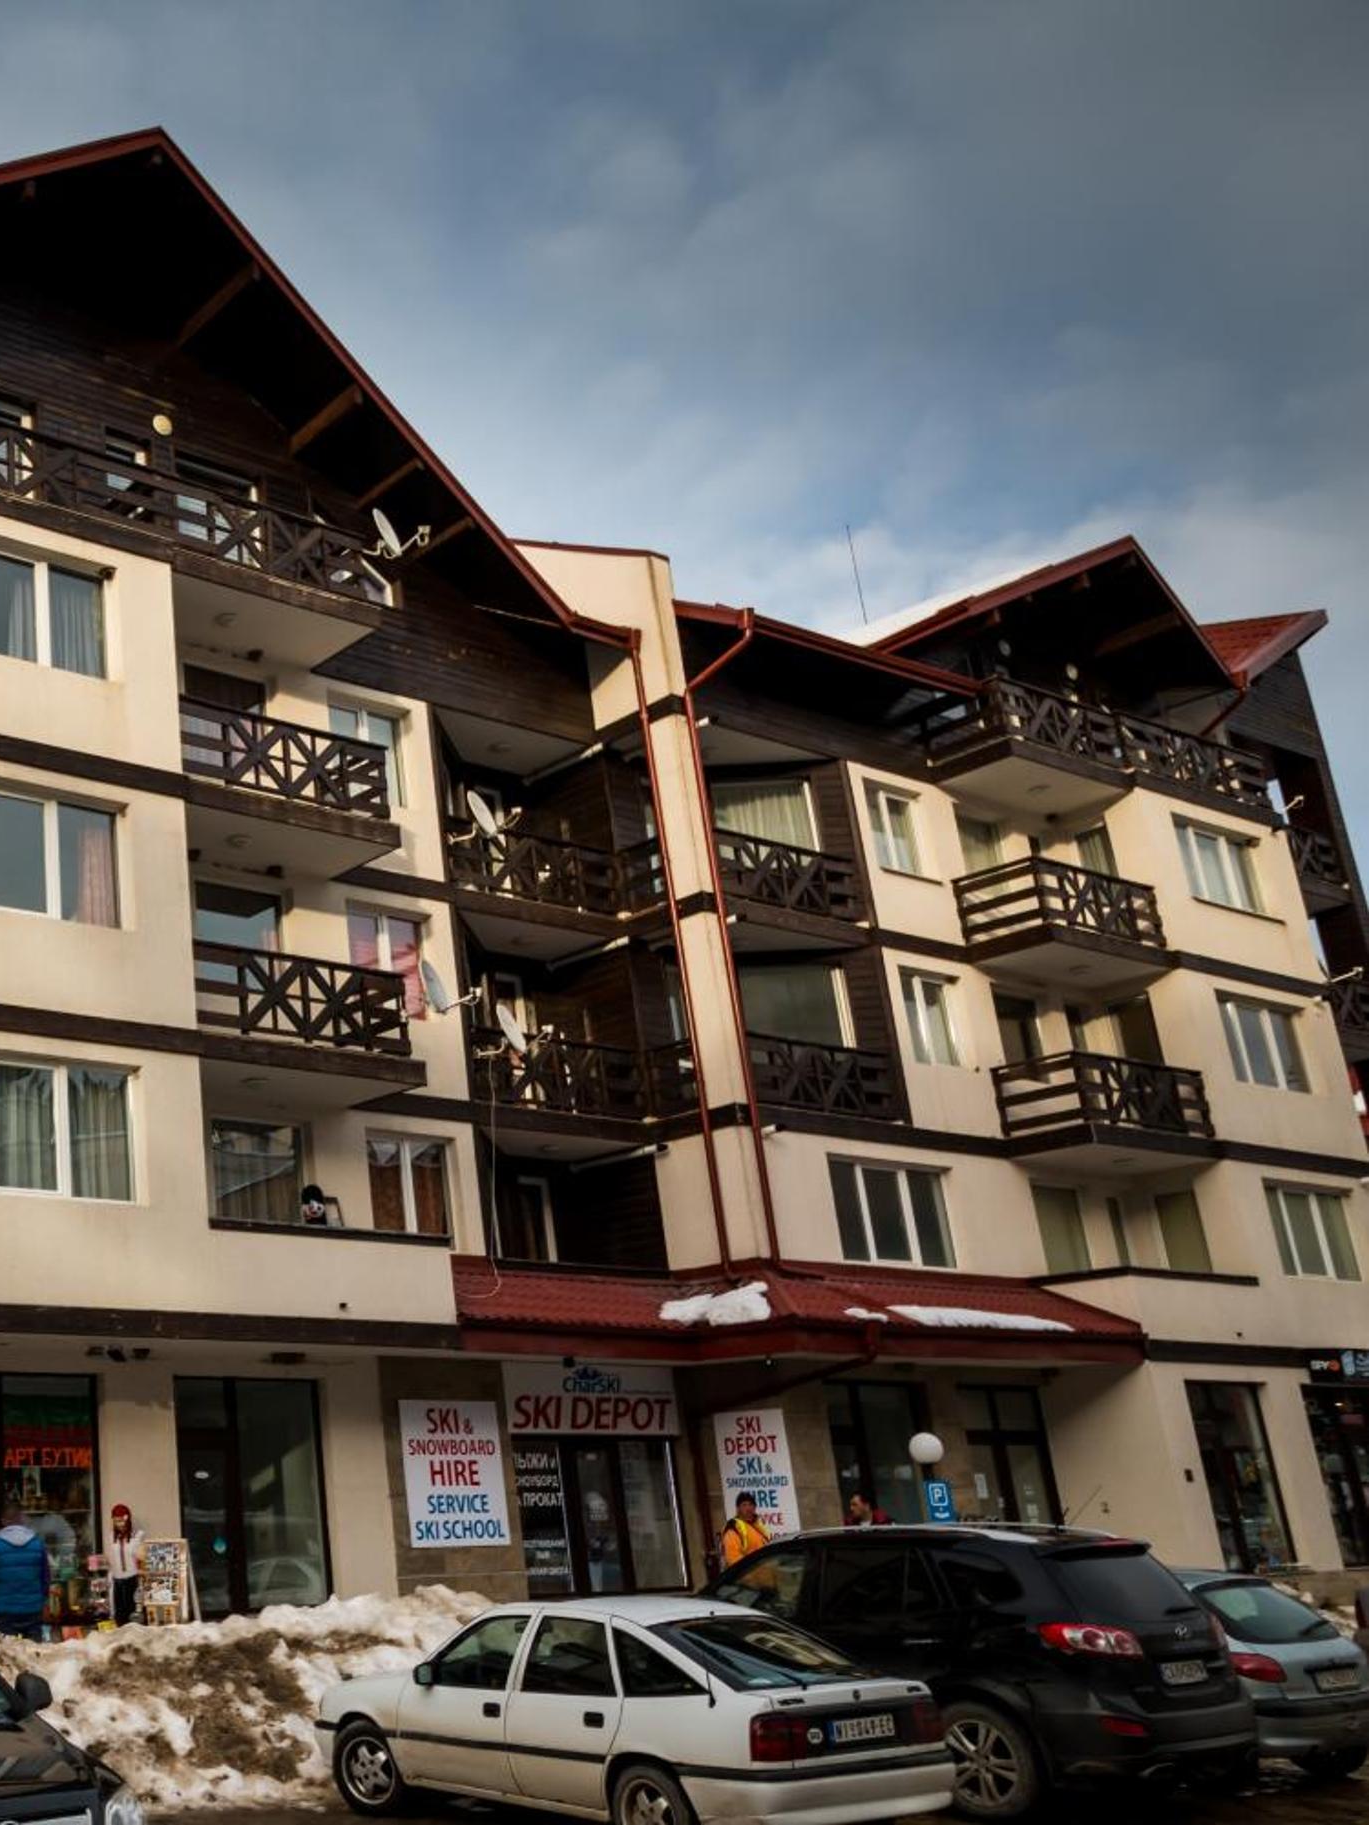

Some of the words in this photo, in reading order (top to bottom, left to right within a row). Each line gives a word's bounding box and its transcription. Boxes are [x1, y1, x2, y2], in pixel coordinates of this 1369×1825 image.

[426, 1407, 460, 1435] SKI
[463, 1418, 473, 1435] &
[512, 1394, 563, 1430] SKI
[570, 1396, 672, 1431] DEPOT
[735, 1416, 762, 1435] SKI
[408, 1439, 496, 1456] SNOWBOARD
[724, 1435, 777, 1455] DEPOT
[429, 1460, 481, 1486] HIRE
[736, 1456, 763, 1475] SKI
[726, 1475, 789, 1488] SNOWBOARD
[427, 1494, 490, 1514] SERVICE
[751, 1489, 779, 1508] IRE
[933, 1488, 942, 1502] P
[415, 1520, 440, 1541] SKI
[443, 1519, 506, 1540] SCHOOL
